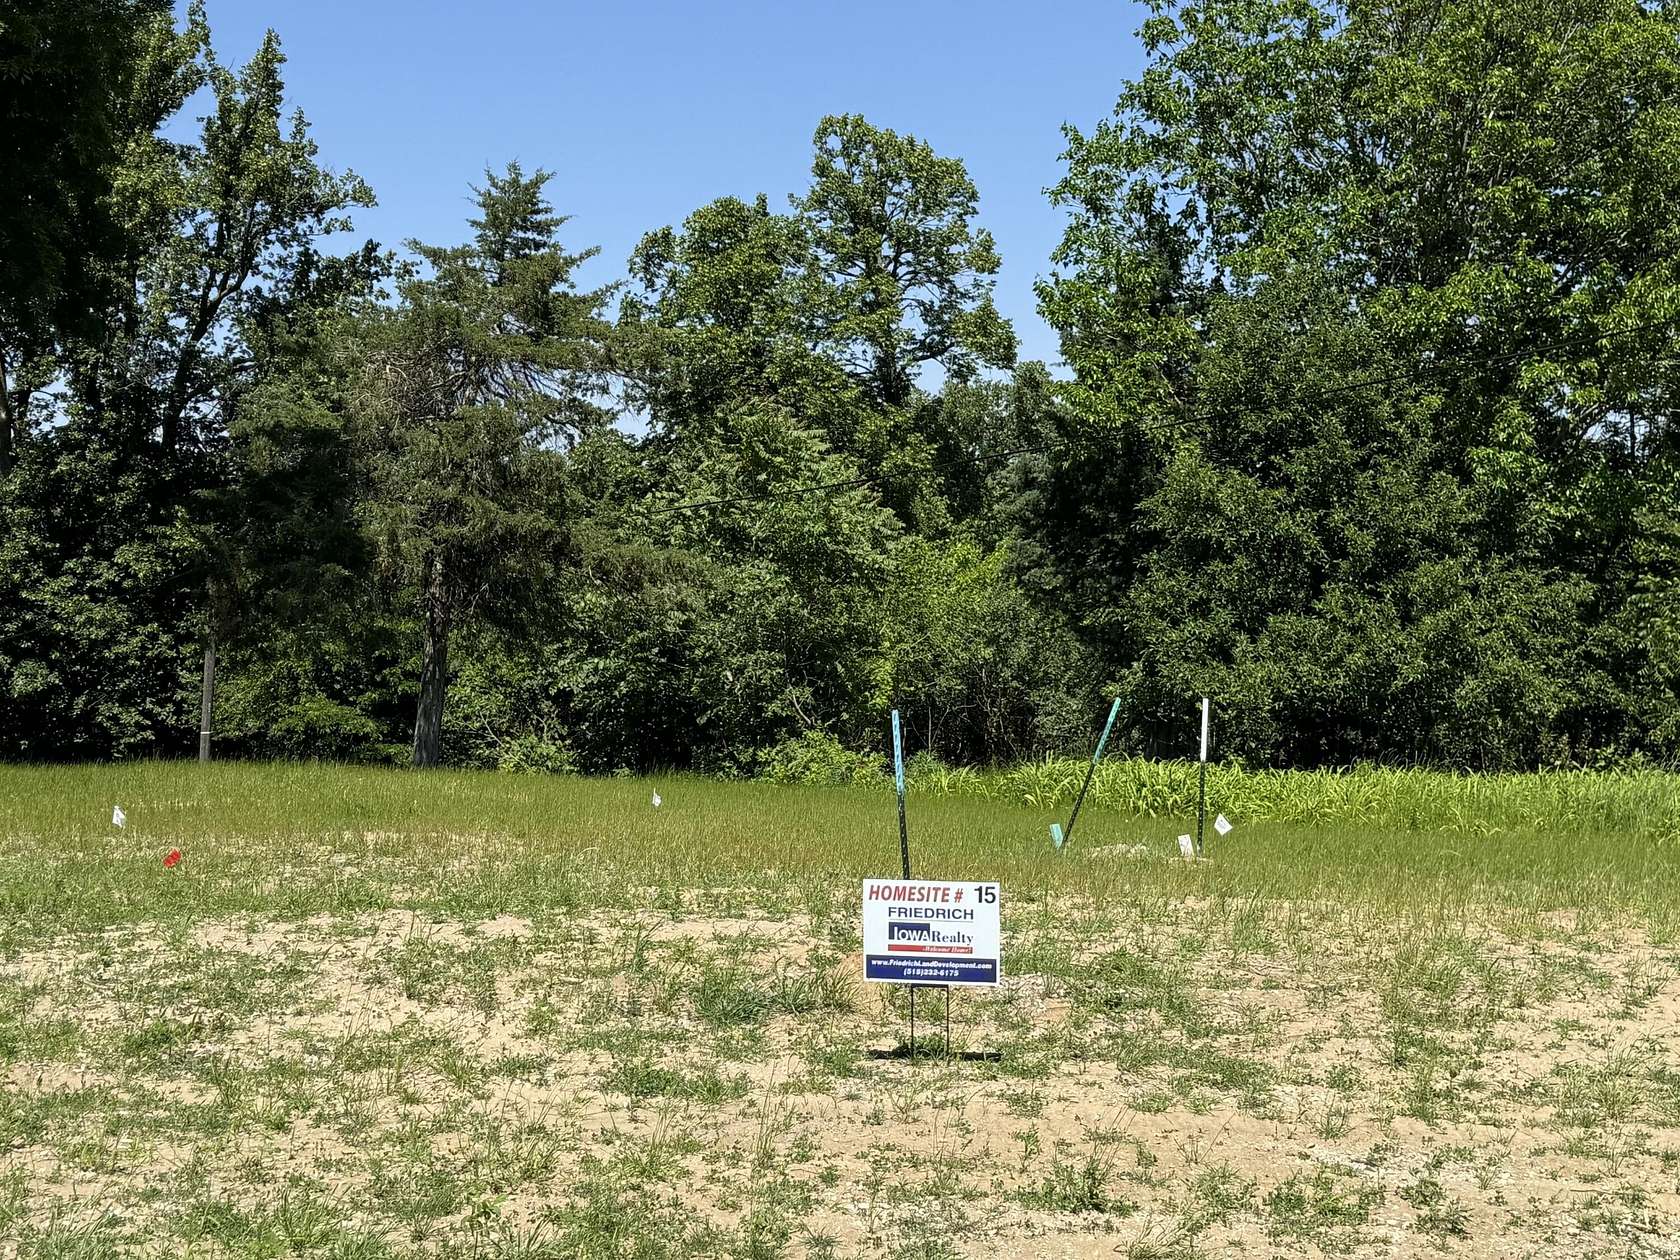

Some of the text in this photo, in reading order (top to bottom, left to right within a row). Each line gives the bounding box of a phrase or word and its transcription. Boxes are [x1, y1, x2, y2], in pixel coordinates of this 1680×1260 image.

[869, 884, 996, 904] HOMESITE # 15
[888, 907, 974, 920] FRIEDRICH
